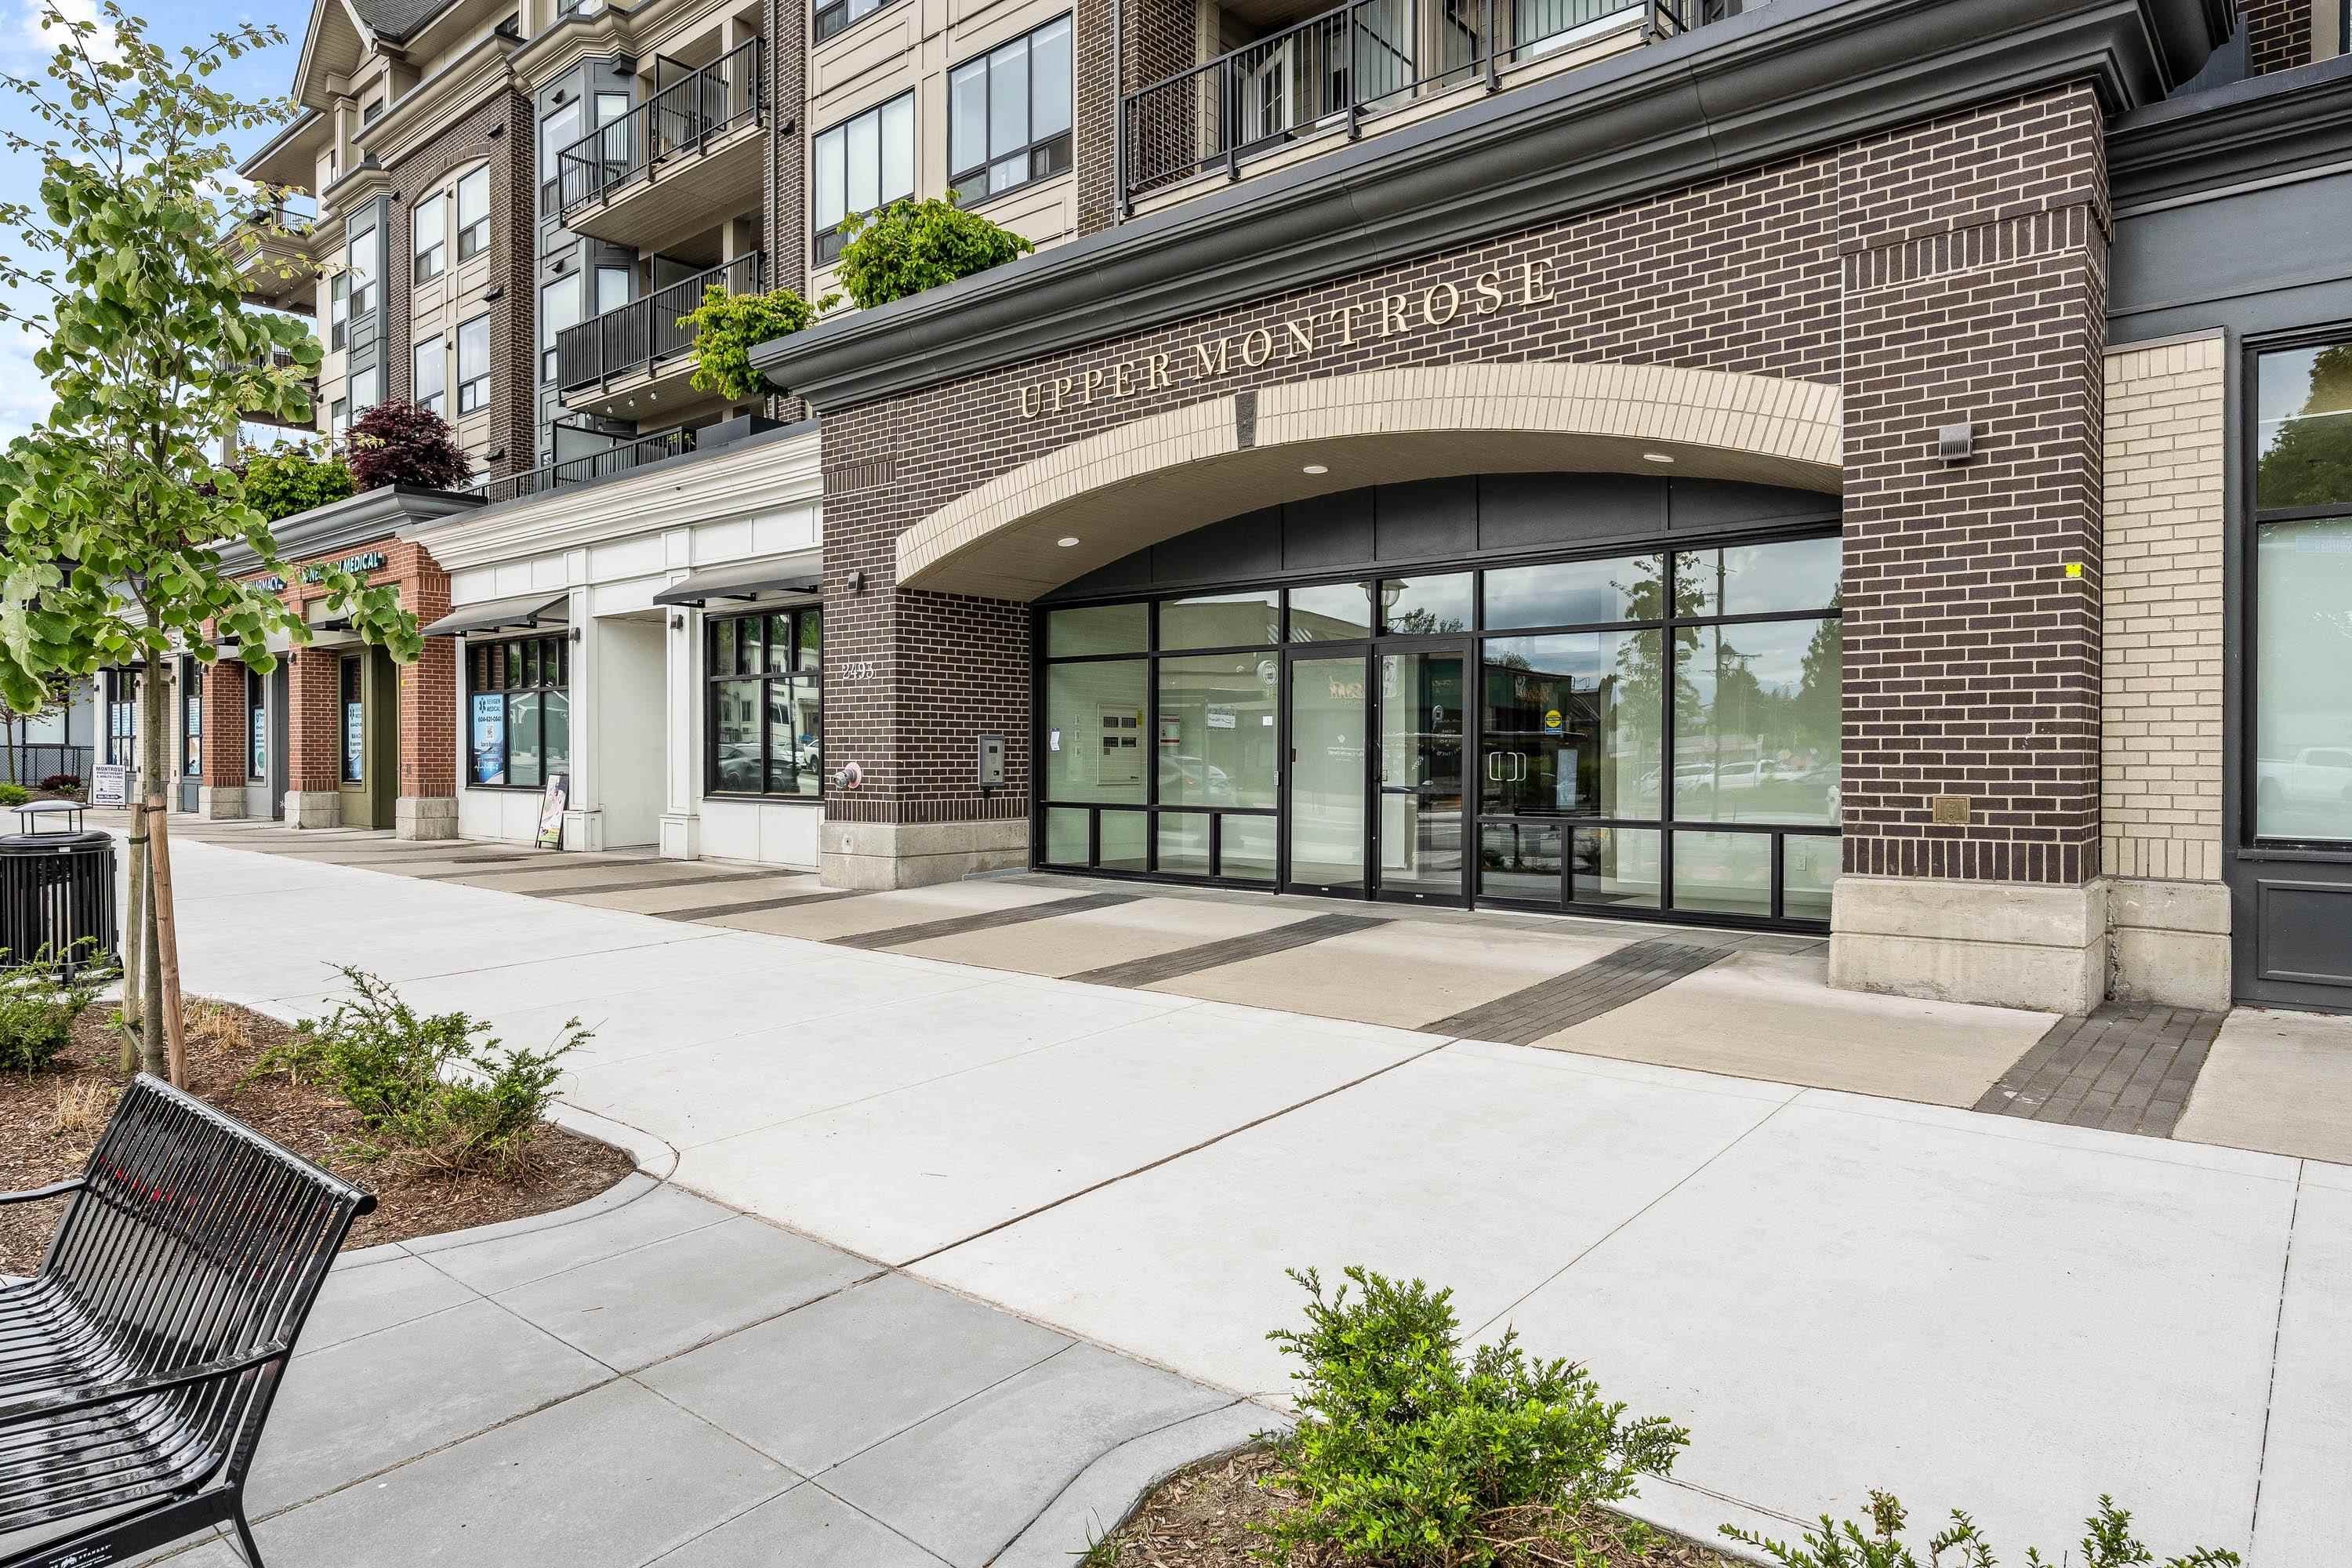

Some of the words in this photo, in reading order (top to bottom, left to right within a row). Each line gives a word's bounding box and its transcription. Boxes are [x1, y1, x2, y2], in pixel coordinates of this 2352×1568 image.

[1020, 352, 1173, 419] UPPER
[1192, 257, 1555, 381] MONTROSE
[343, 553, 378, 572] MEDICAL
[843, 662, 874, 680] 2493
